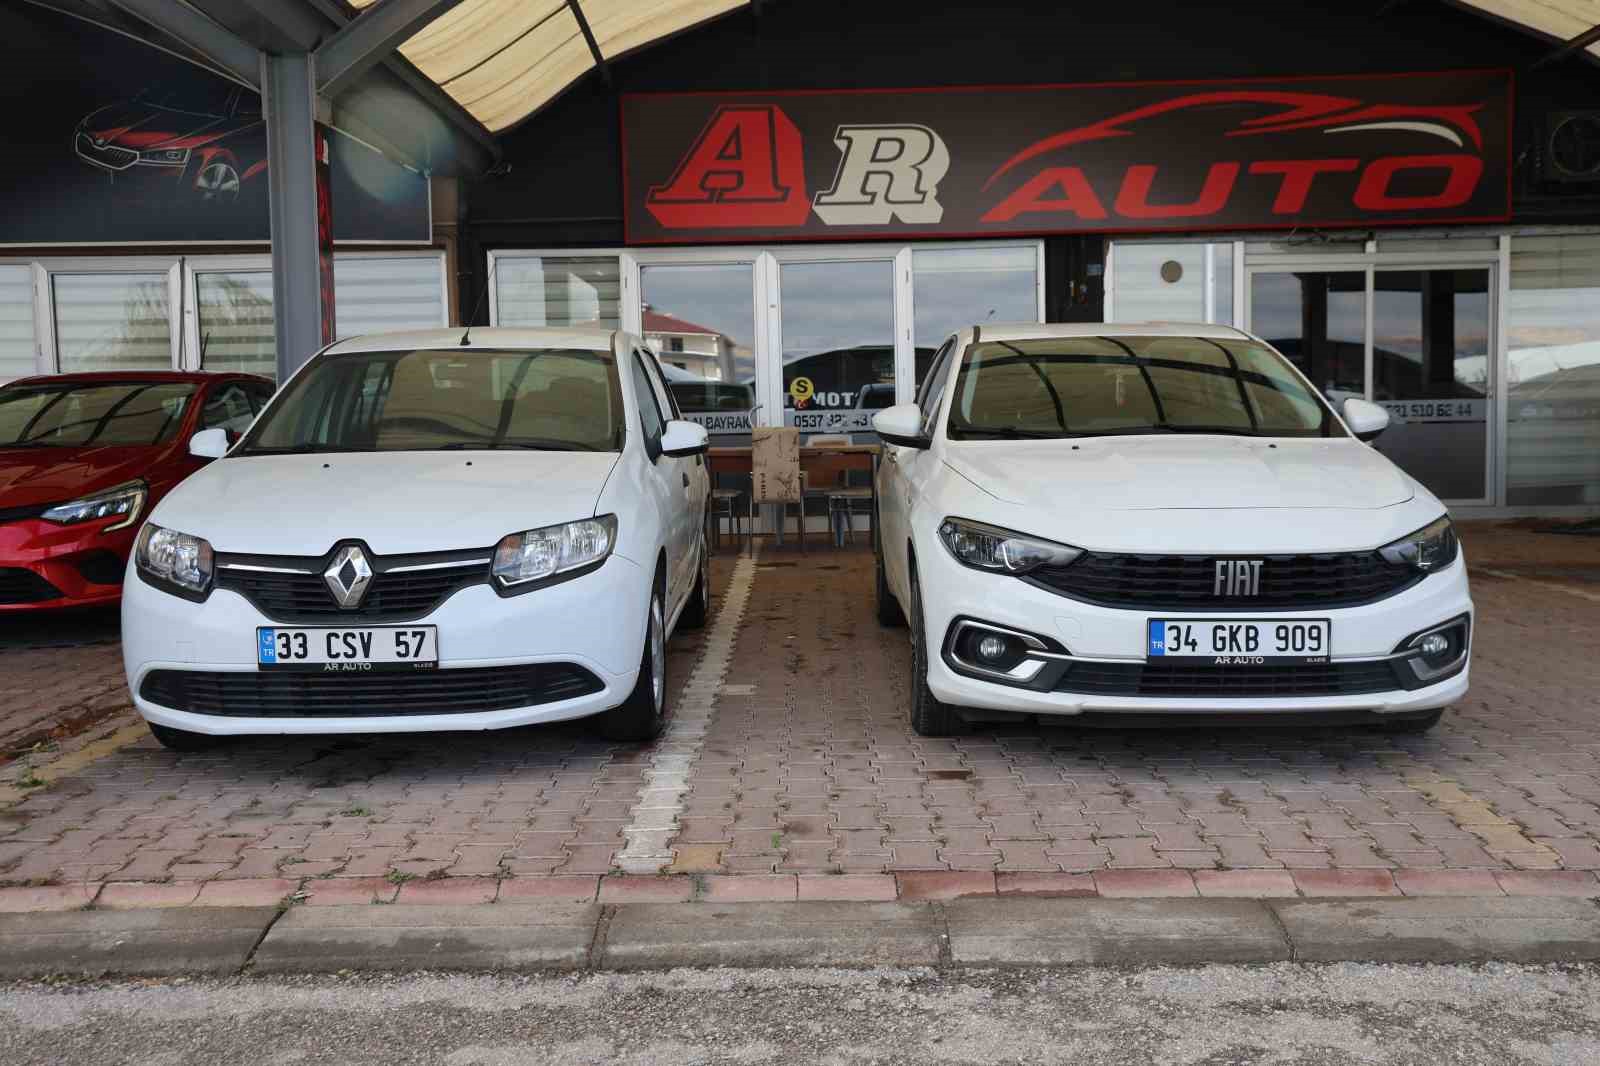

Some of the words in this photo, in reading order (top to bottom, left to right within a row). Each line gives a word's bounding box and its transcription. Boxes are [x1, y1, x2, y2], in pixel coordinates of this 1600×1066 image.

[646, 103, 951, 229] AR
[979, 154, 1484, 222] AUTO
[1455, 403, 1473, 416] 44
[794, 414, 824, 428] 0537
[1213, 560, 1264, 596] FIAT
[263, 648, 275, 657] TR
[277, 632, 308, 659] 33
[326, 631, 373, 659] CSV
[395, 631, 426, 658] 57
[1152, 641, 1163, 649] TR
[1167, 625, 1197, 652] 34
[1212, 625, 1259, 652] GKB
[1275, 625, 1322, 652] 909
[323, 663, 339, 671] AR
[342, 662, 372, 671] AUTO
[1215, 656, 1230, 664] AR
[1231, 656, 1264, 664] AUTO
